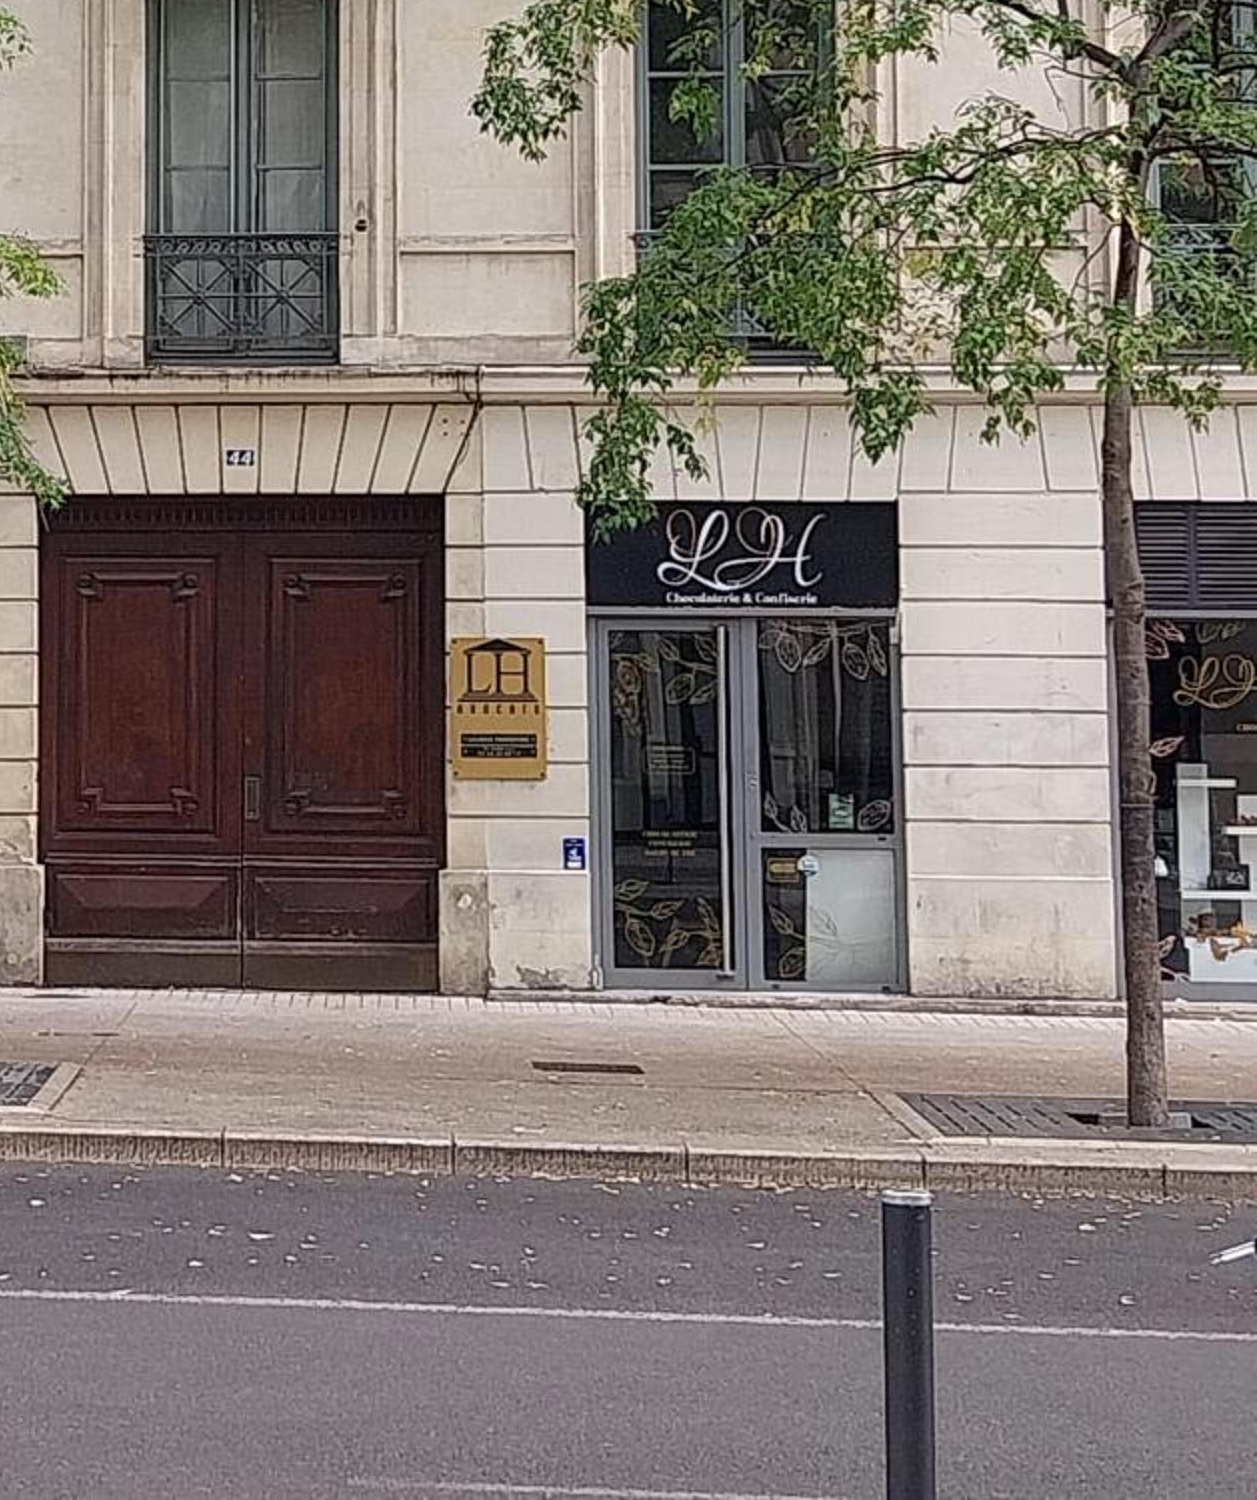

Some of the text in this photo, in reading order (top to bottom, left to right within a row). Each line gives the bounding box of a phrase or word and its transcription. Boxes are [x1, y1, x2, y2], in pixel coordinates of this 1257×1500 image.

[228, 451, 253, 466] 44
[665, 591, 818, 605] Chocolaterie & Confiserie
